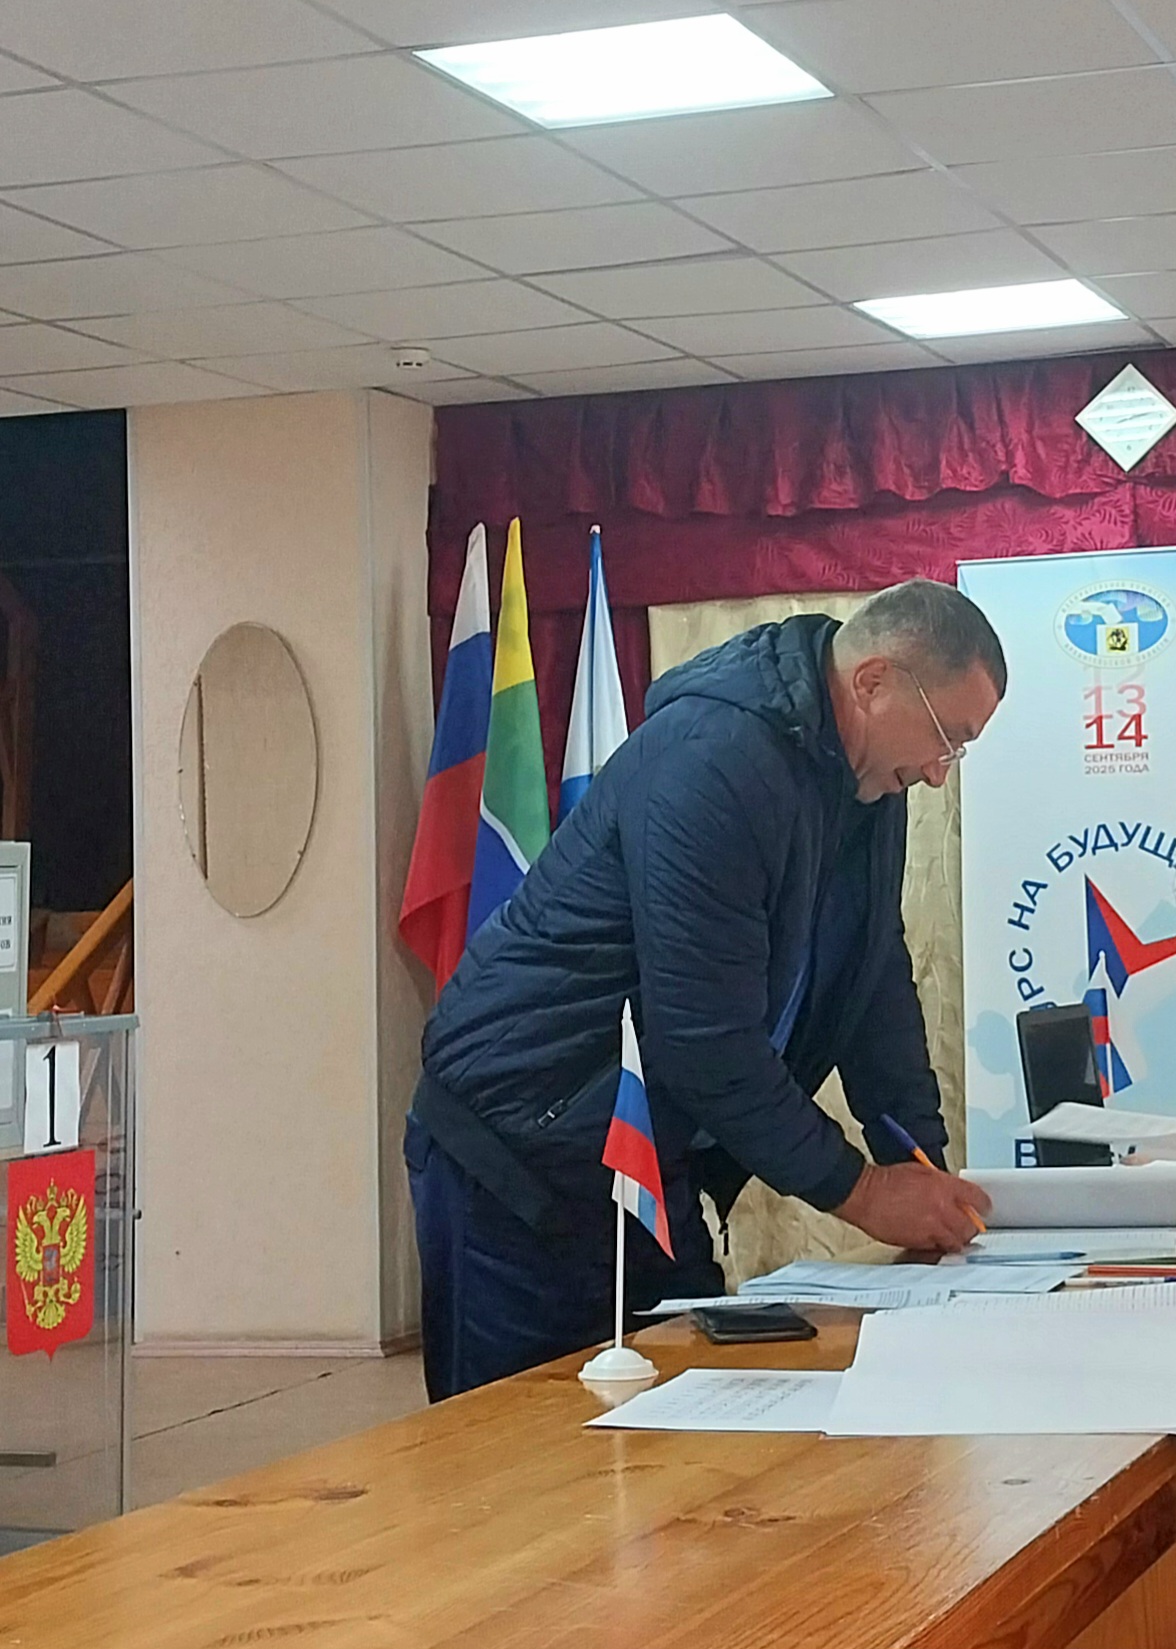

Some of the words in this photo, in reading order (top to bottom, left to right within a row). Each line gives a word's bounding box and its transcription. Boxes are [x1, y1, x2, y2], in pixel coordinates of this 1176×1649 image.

[1082, 684, 1148, 720] 13
[1084, 713, 1149, 750] 14
[1084, 751, 1150, 763] СЕНТЯБРЯ
[1119, 763, 1150, 773] ГОДА
[1007, 879, 1049, 931] НА
[1008, 947, 1058, 1011] РС
[42, 1044, 62, 1148] 1
